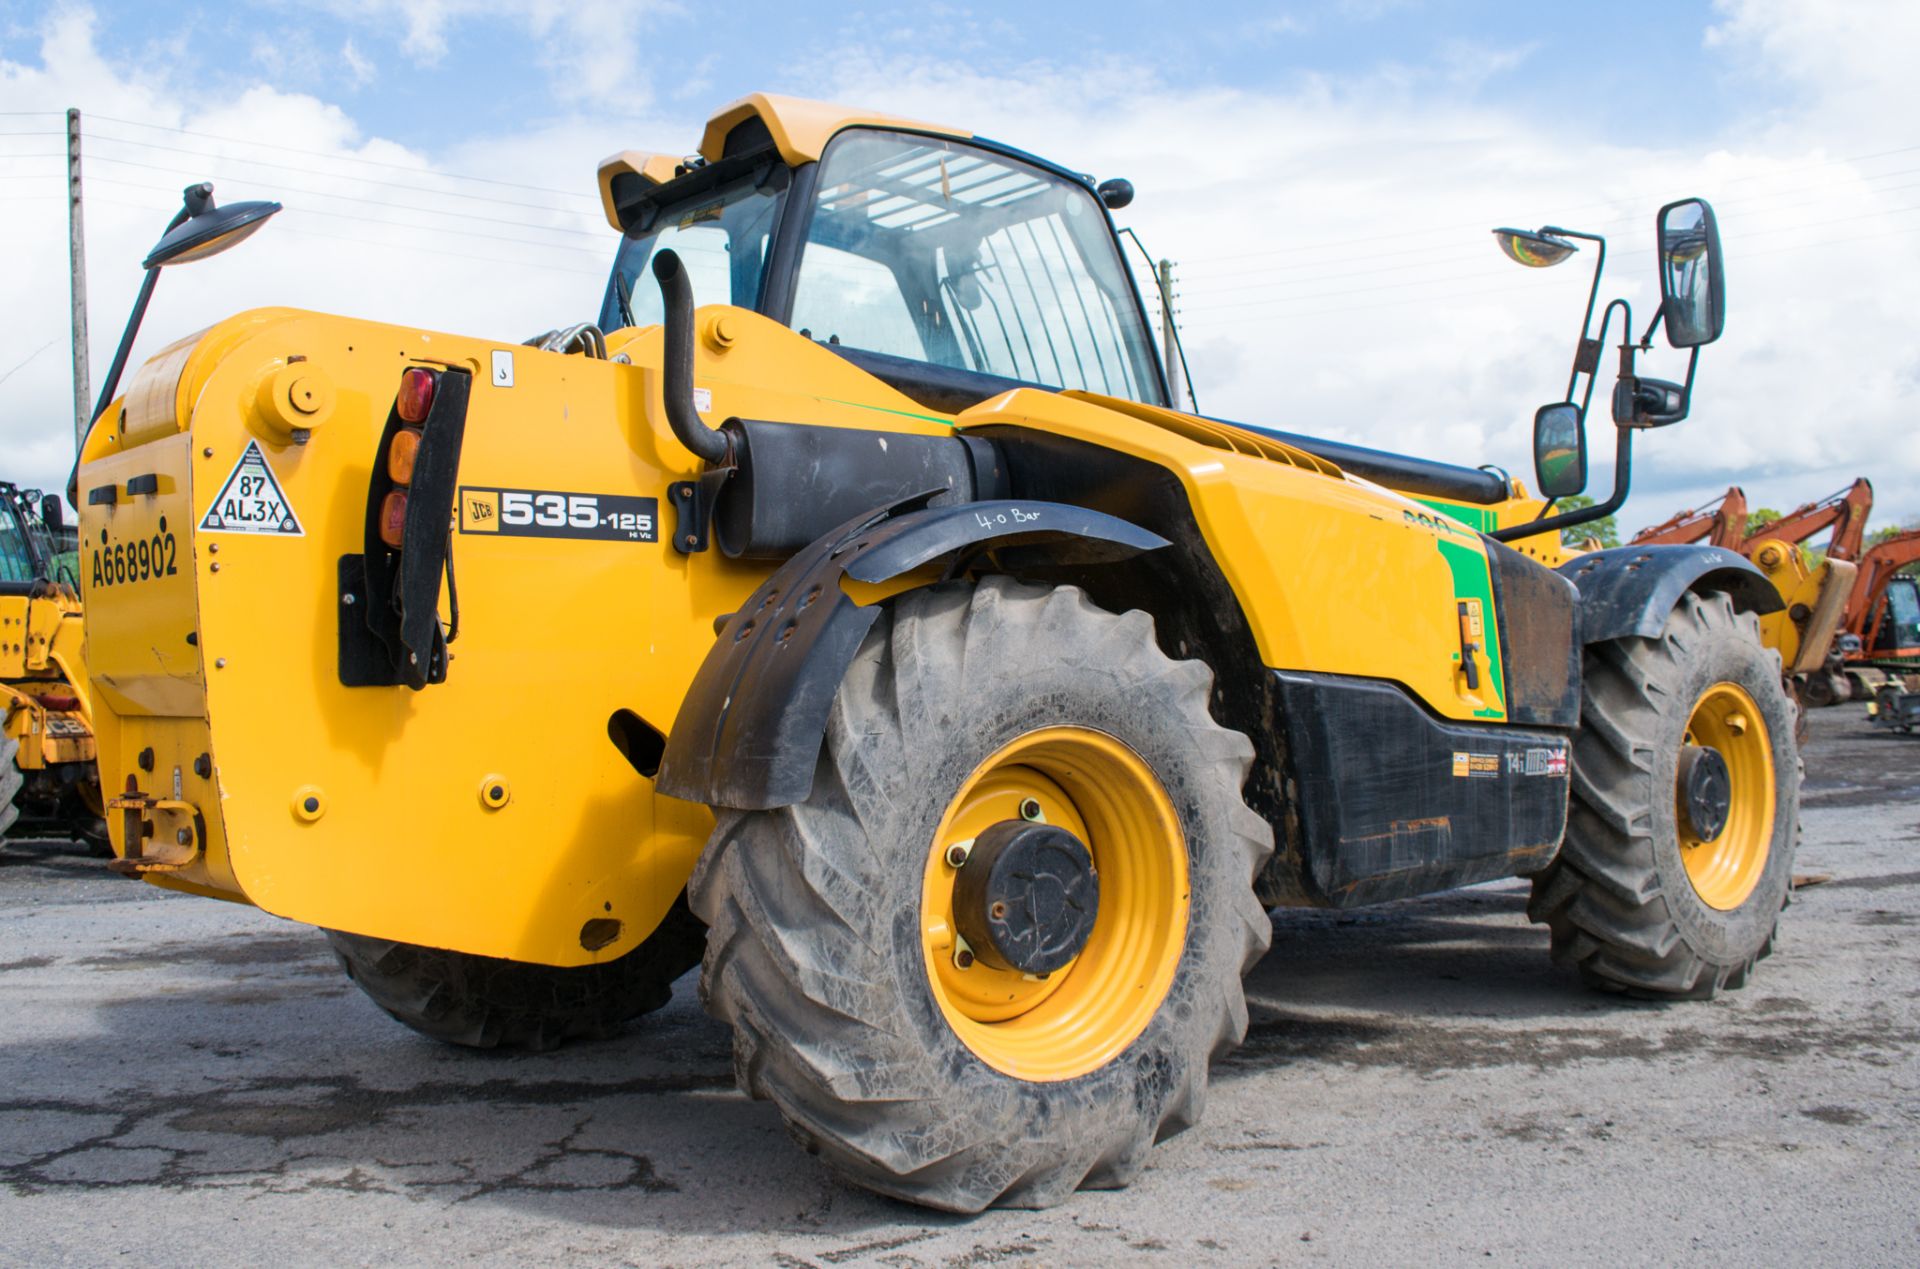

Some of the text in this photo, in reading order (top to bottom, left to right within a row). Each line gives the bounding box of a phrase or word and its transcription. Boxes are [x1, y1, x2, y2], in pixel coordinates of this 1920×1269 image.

[240, 476, 266, 497] 87
[224, 499, 280, 523] AL3X
[472, 501, 494, 520] JCB
[501, 492, 652, 531] 535-125
[1010, 508, 1041, 523] Bar
[92, 532, 177, 588] A668902
